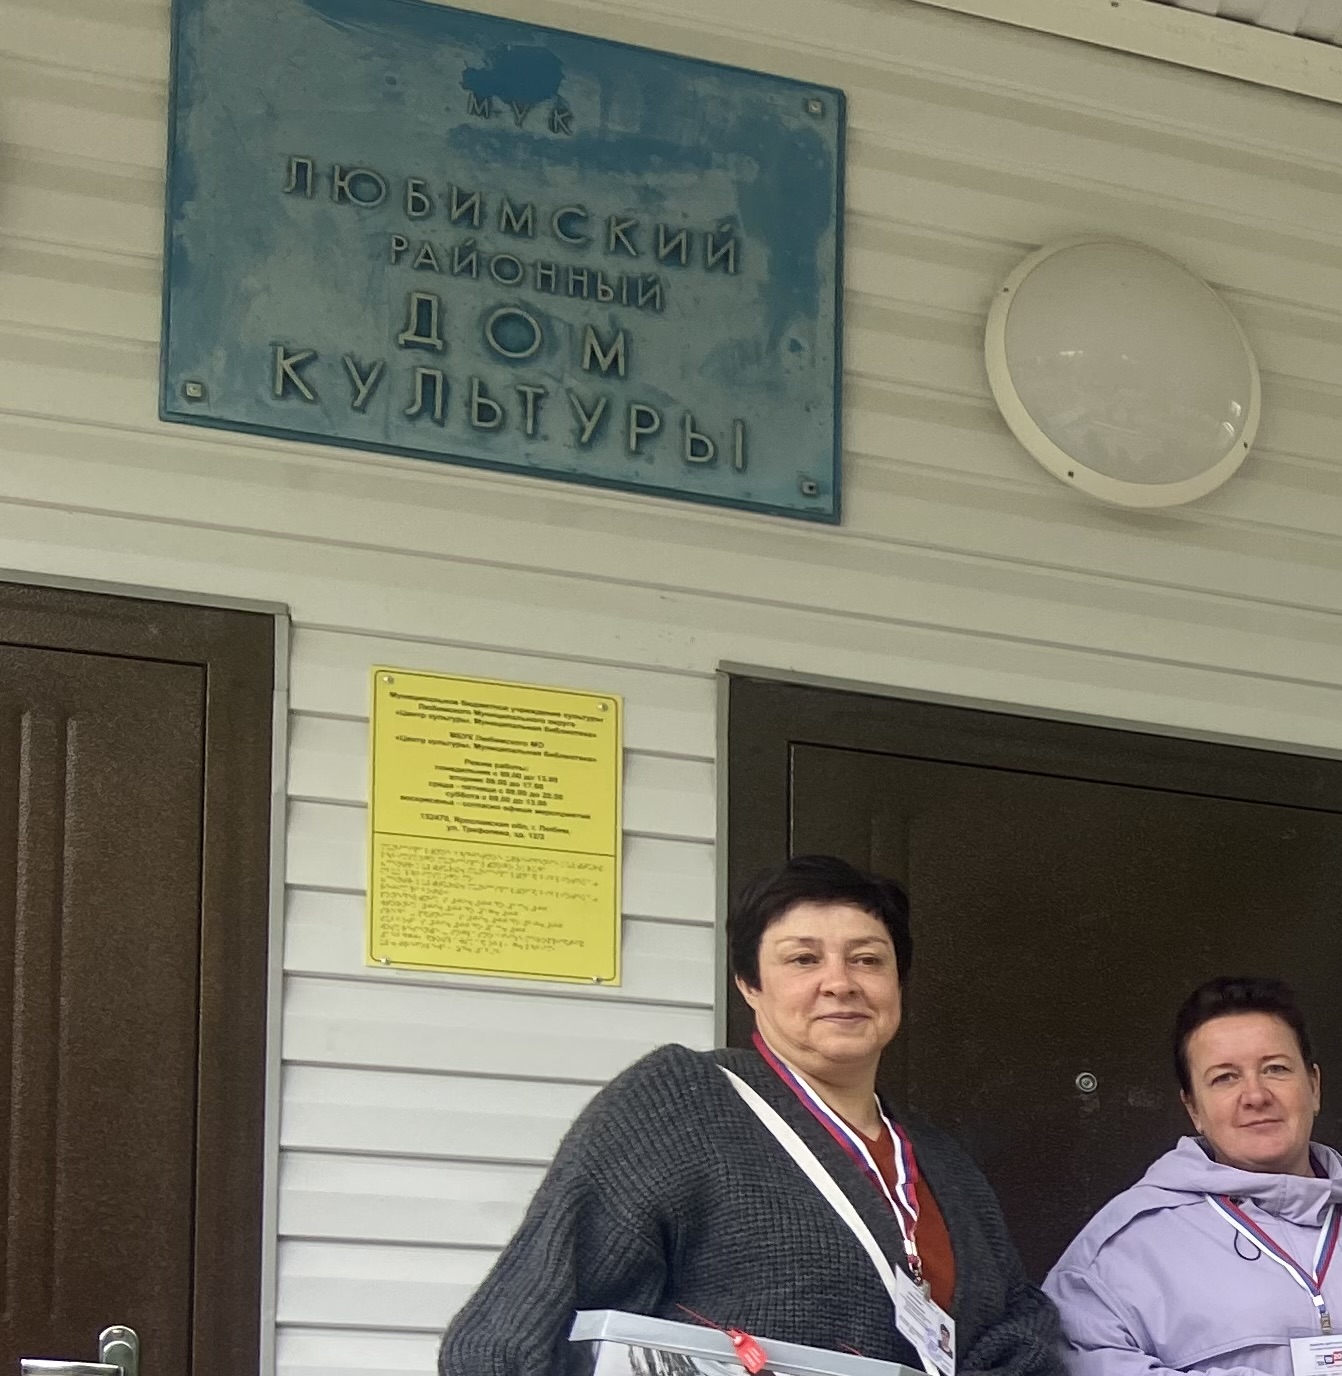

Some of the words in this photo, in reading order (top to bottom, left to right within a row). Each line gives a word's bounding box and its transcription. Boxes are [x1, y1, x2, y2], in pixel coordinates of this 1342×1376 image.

[284, 156, 739, 275] ЛЮБИМСКИЙ
[391, 234, 665, 310] РАЙОННЫЙ
[398, 292, 627, 376] ДОМ
[273, 346, 746, 471] КУЛЬТУРЫ
